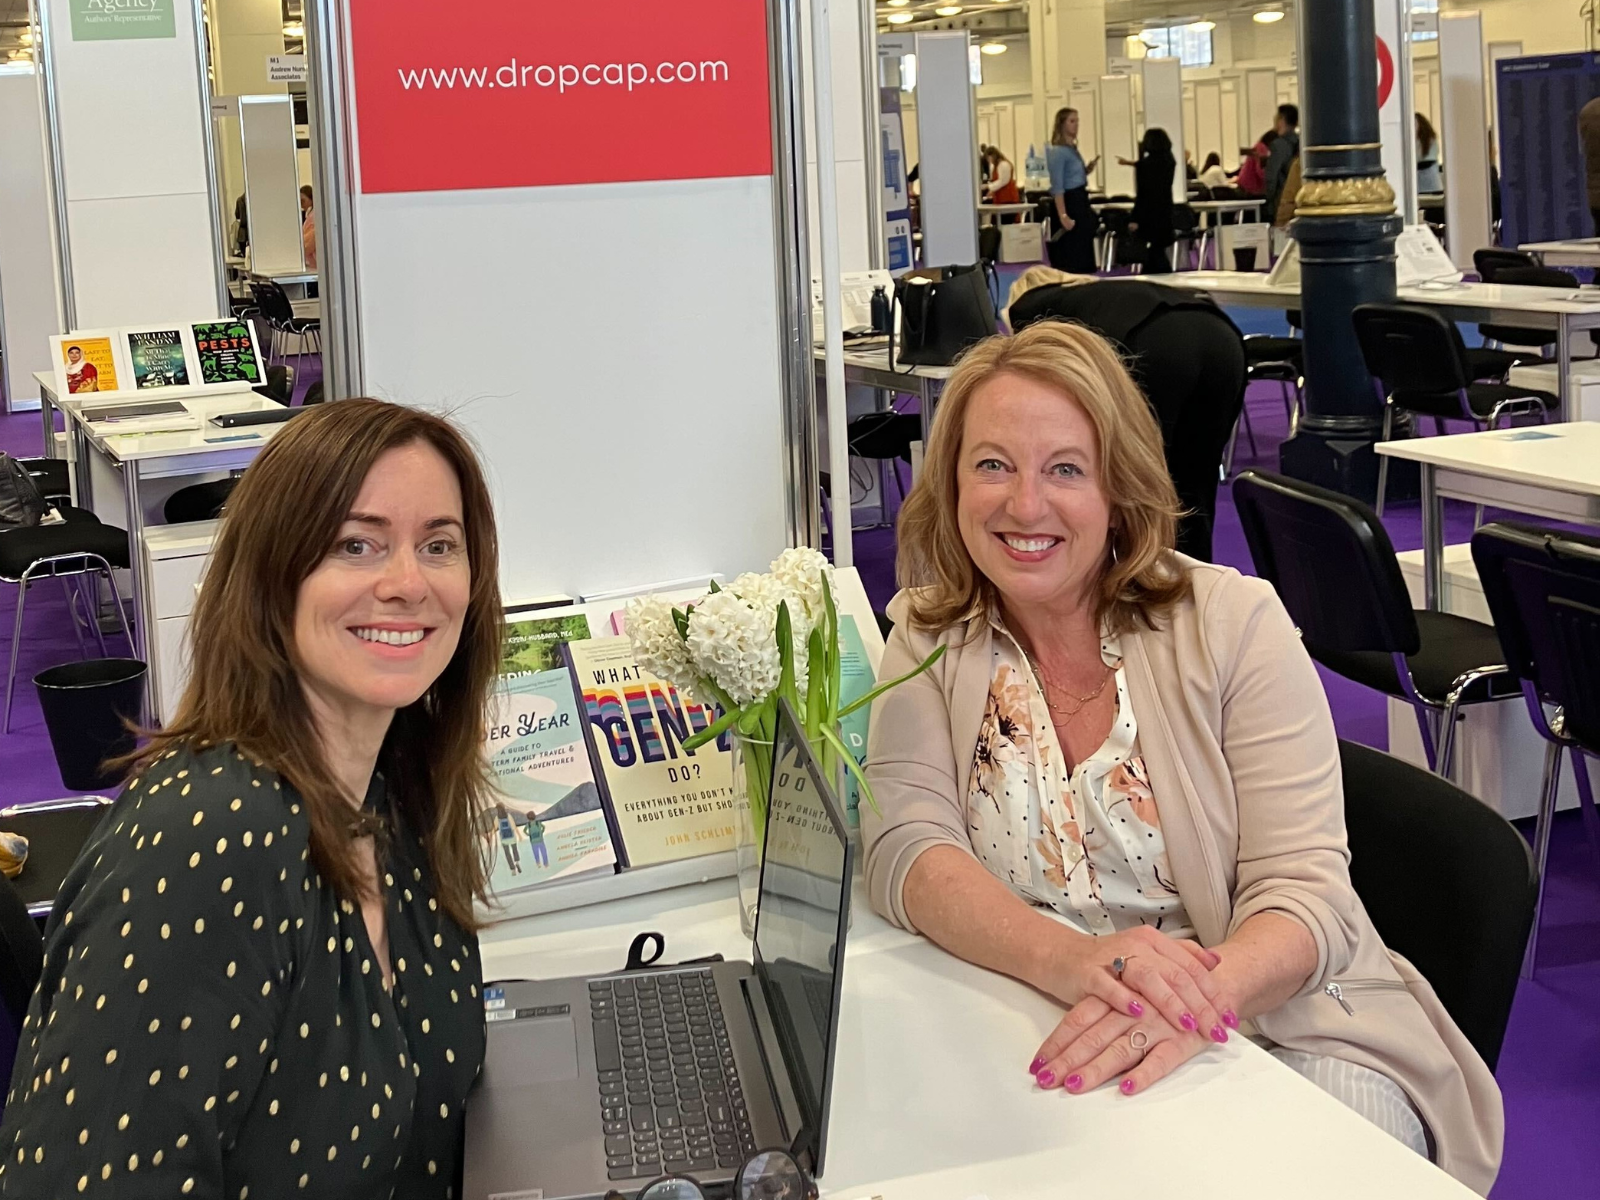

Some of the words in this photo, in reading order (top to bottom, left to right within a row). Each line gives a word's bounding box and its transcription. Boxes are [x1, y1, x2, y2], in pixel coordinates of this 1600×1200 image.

[87, 0, 157, 13] Agency
[114, 14, 161, 24] Representative
[397, 57, 729, 94] www.dropcap.com
[198, 338, 250, 350] PESTS
[592, 664, 640, 685] WHAT
[490, 724, 511, 741] ER
[516, 712, 570, 736] YEAR
[508, 744, 529, 754] GUIDE
[532, 742, 542, 750] TO
[512, 754, 536, 764] FAMILY
[540, 748, 566, 758] TRAVEL
[528, 756, 574, 770] ADVENTURES
[668, 764, 701, 783] DO?
[624, 796, 678, 812] EVERYTHING
[680, 792, 698, 802] YOU
[700, 788, 726, 800] DON'T
[637, 812, 664, 823] ABOUT
[668, 806, 694, 818] GEN-Z
[698, 802, 714, 813] BUT
[666, 834, 690, 846] JOHN
